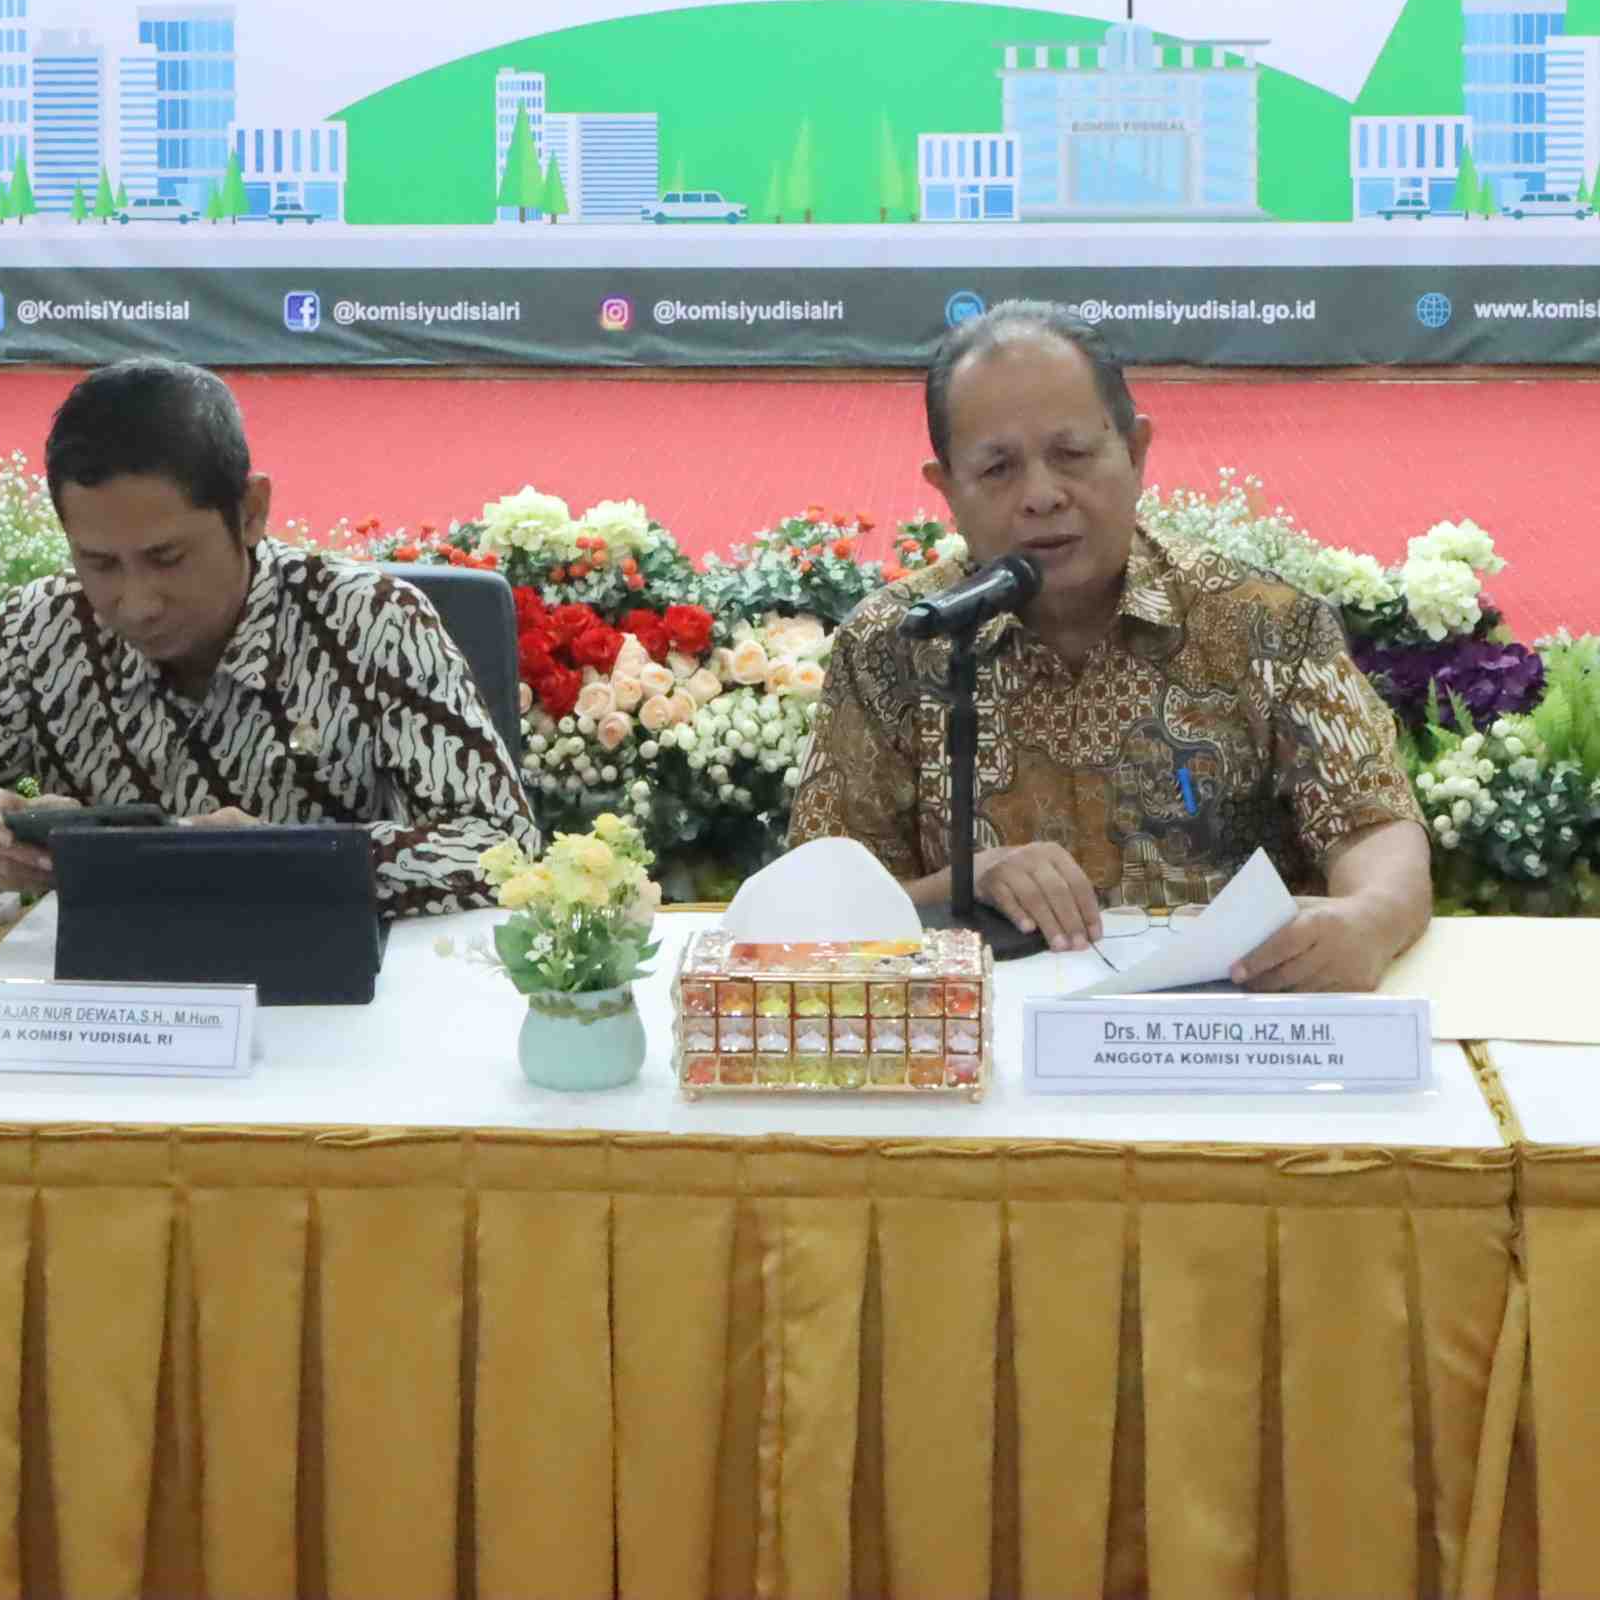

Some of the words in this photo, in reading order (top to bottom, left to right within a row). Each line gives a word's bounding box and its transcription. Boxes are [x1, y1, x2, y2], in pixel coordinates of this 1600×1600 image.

[332, 299, 521, 326] @komisiyudisialri
[652, 299, 844, 326] @komisiyudisialri
[44, 1006, 73, 1020] NUR
[17, 1028, 73, 1042] KOMISI
[79, 1030, 152, 1045] YUDISIAL
[158, 1033, 173, 1046] RI
[1104, 1022, 1140, 1041] Drs.
[1146, 1023, 1166, 1041] M.
[1175, 1024, 1243, 1042] TAUFIQ
[1094, 1052, 1175, 1065] ANGGOTA
[1180, 1052, 1240, 1065] KOMISI
[1246, 1052, 1323, 1066] YUDISIAL
[1329, 1053, 1344, 1066] RI
